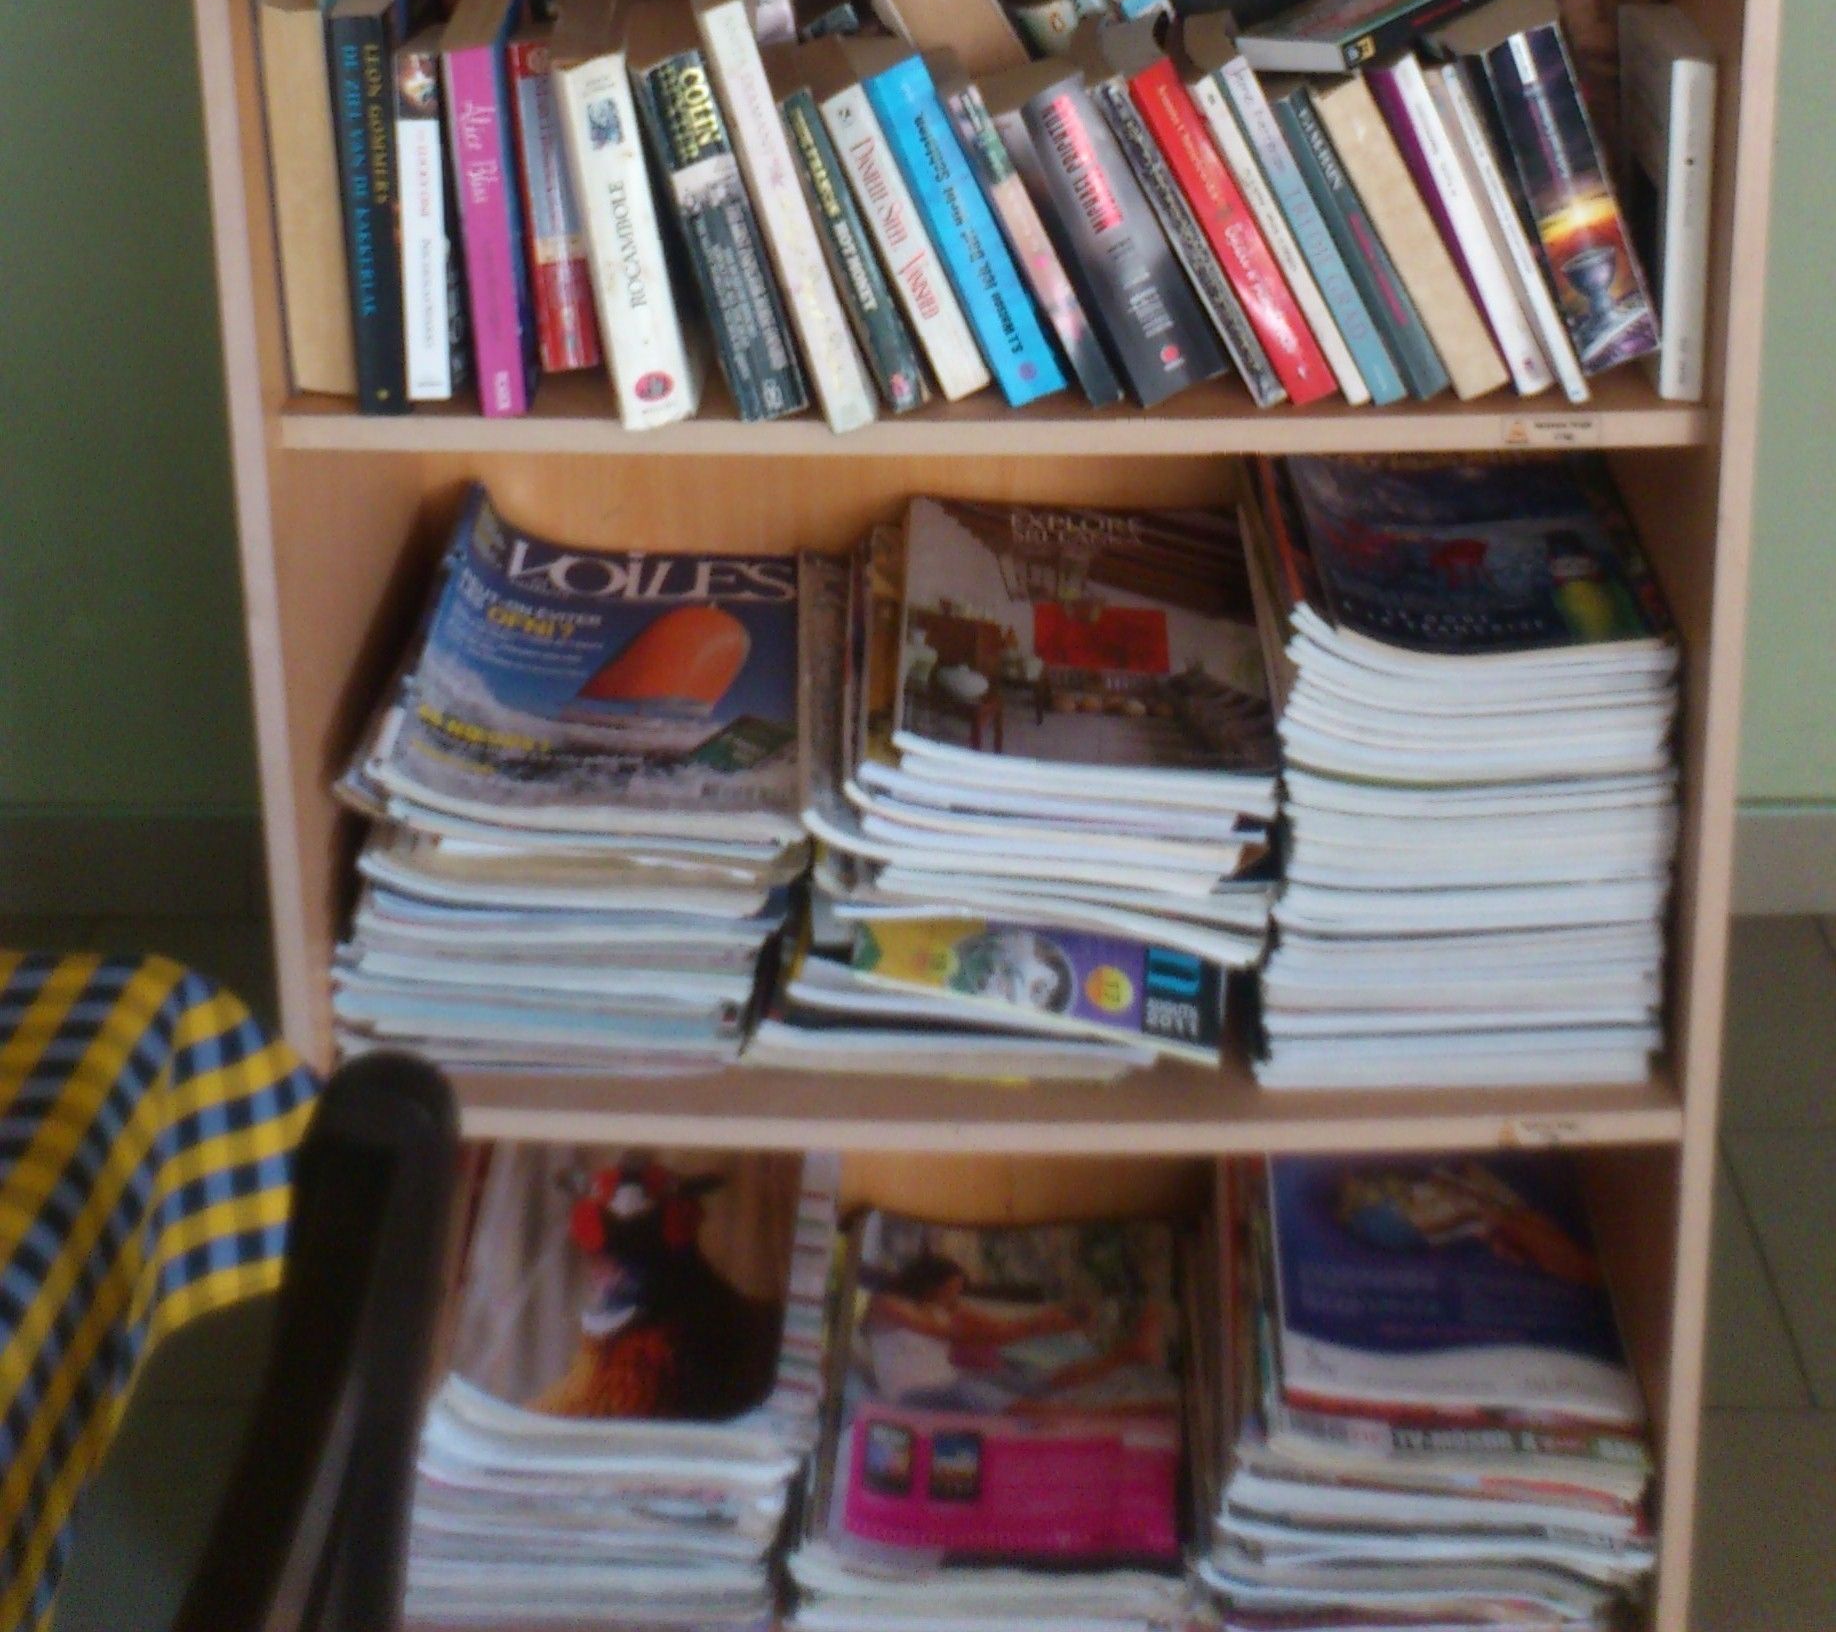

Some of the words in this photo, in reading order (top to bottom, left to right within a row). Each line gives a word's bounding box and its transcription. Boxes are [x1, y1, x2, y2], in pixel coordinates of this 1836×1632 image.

[364, 44, 384, 98] LEON
[674, 63, 723, 148] COLIN
[347, 128, 367, 168] VAN
[366, 103, 391, 205] GOMMERS
[459, 99, 497, 151] Alice
[1036, 93, 1099, 175] CRICHTON
[466, 157, 501, 204] Bliss
[354, 206, 378, 318] KAKKERLAK
[607, 178, 648, 310] ROCAMBOLE
[831, 219, 859, 259] HOT
[845, 256, 881, 314] MONEY
[1009, 513, 1142, 533] EXPLORE
[507, 539, 796, 601] VOILES
